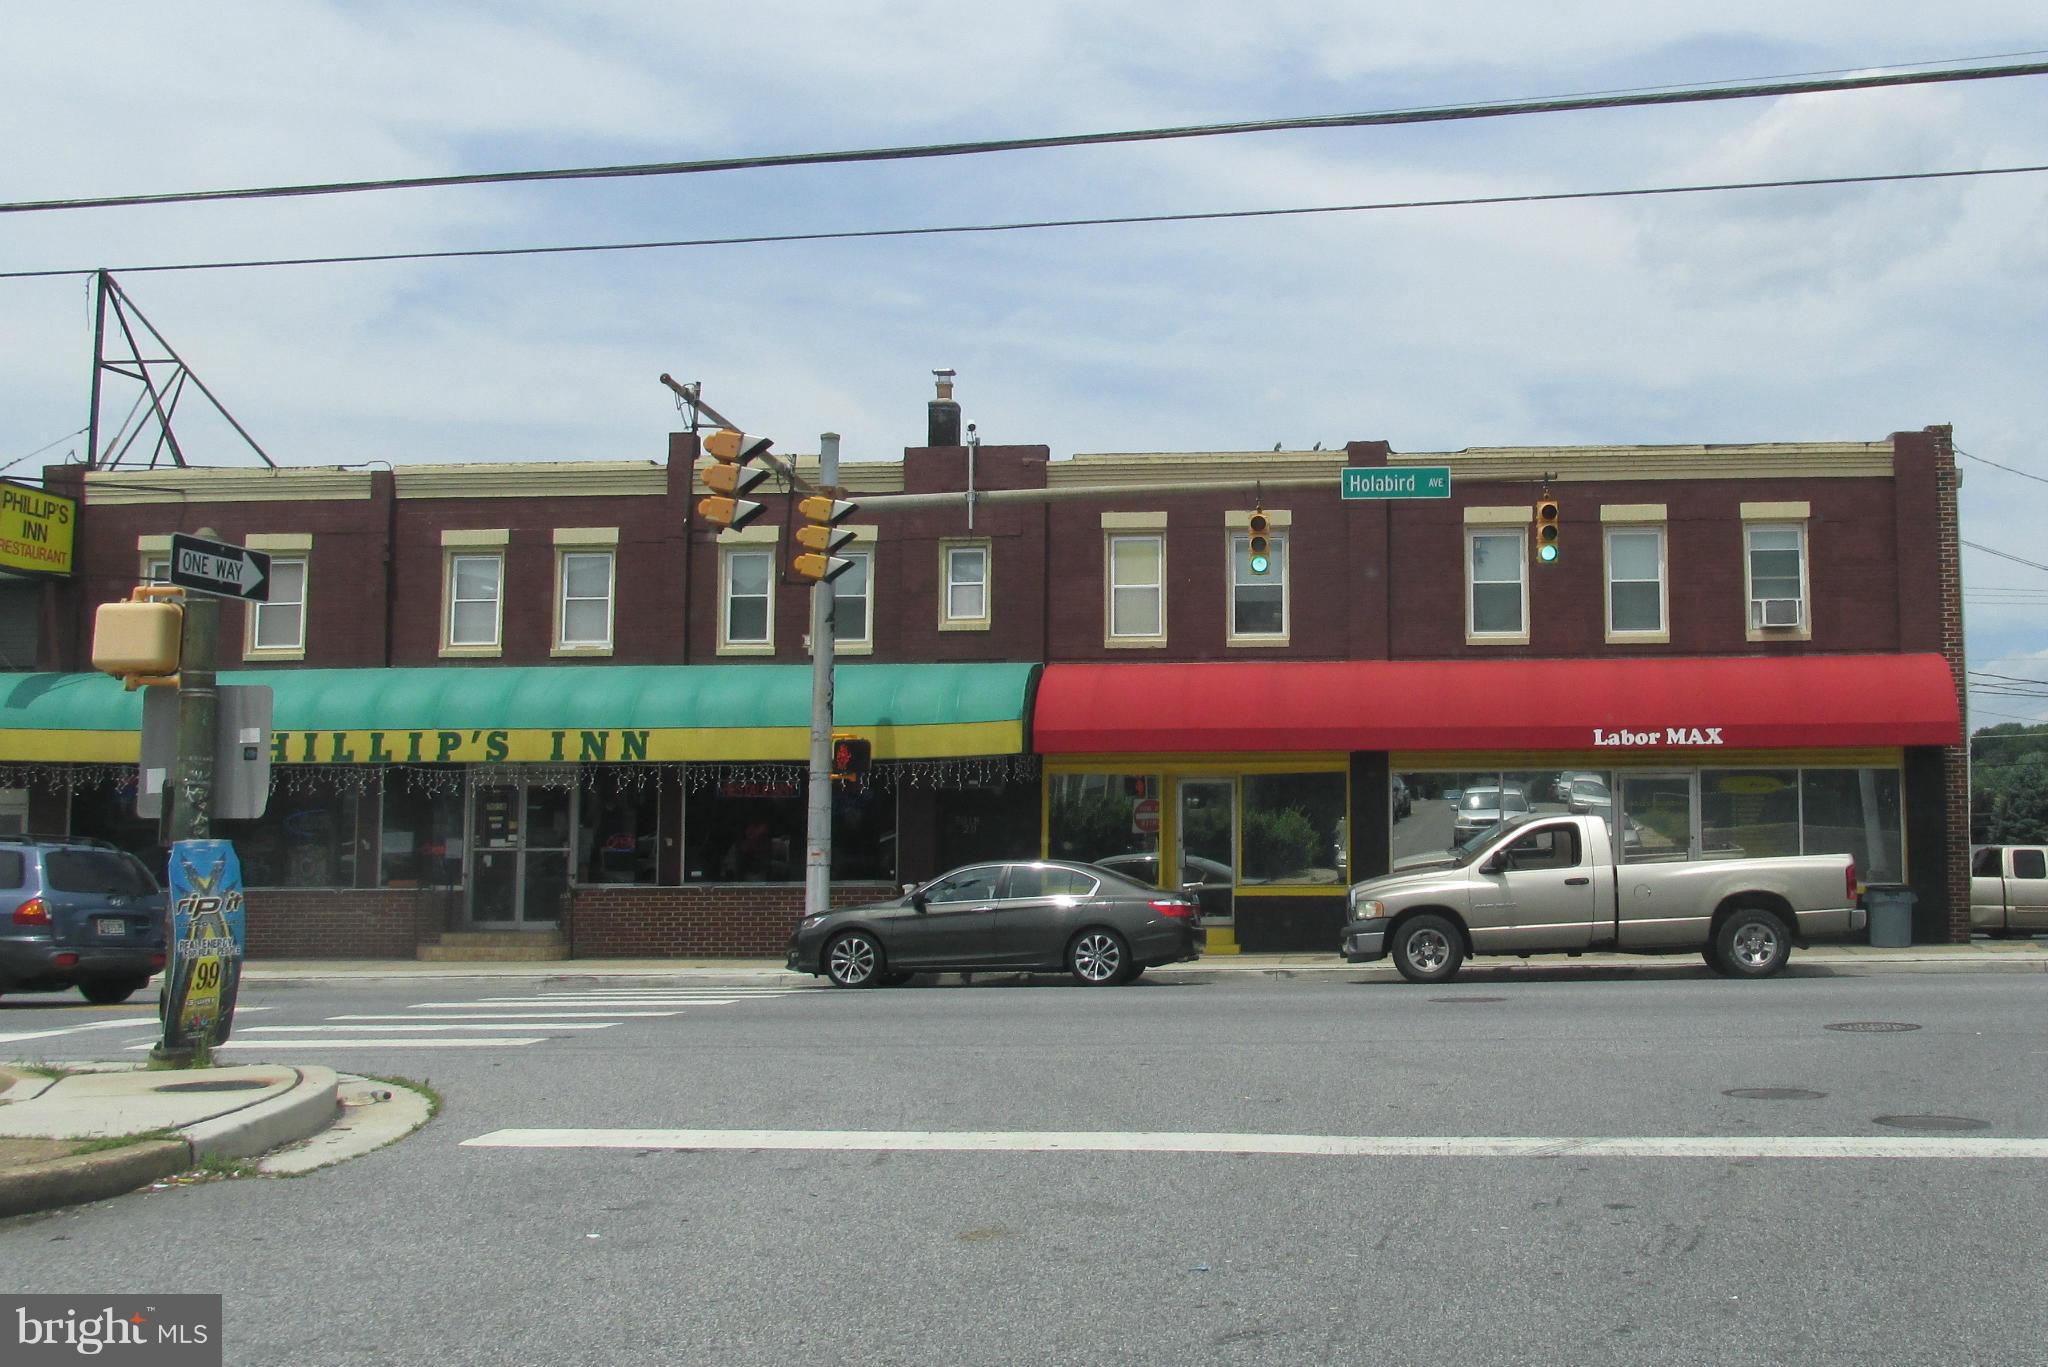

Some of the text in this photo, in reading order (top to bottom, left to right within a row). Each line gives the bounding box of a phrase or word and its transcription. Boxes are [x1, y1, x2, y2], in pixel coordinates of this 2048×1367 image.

[1350, 475, 1444, 492] Holabird AVE
[3, 490, 68, 524] PHILLIP'S
[22, 520, 48, 543] INN
[0, 539, 68, 565] RESTAURANT
[183, 552, 243, 581] ONE WAY
[271, 731, 650, 762] HILLIP'S INN
[1593, 728, 1723, 745] Labor MAX
[175, 891, 243, 921] rip it
